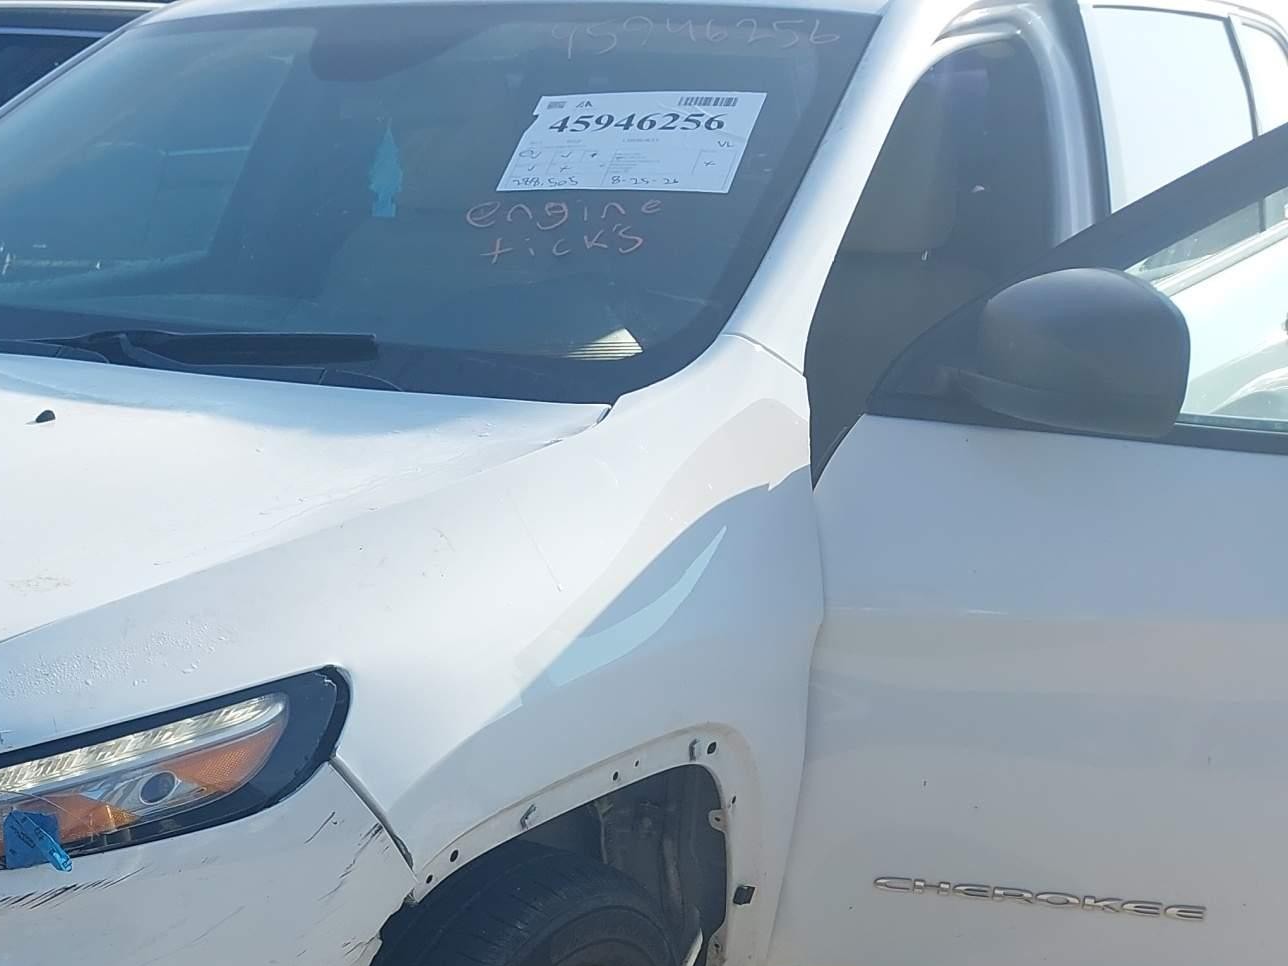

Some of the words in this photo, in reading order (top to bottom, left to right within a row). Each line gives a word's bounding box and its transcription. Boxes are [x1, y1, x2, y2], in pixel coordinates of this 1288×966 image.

[548, 112, 727, 132] 45946256
[466, 199, 662, 230] engine
[873, 876, 1207, 921] CHEROKEE
